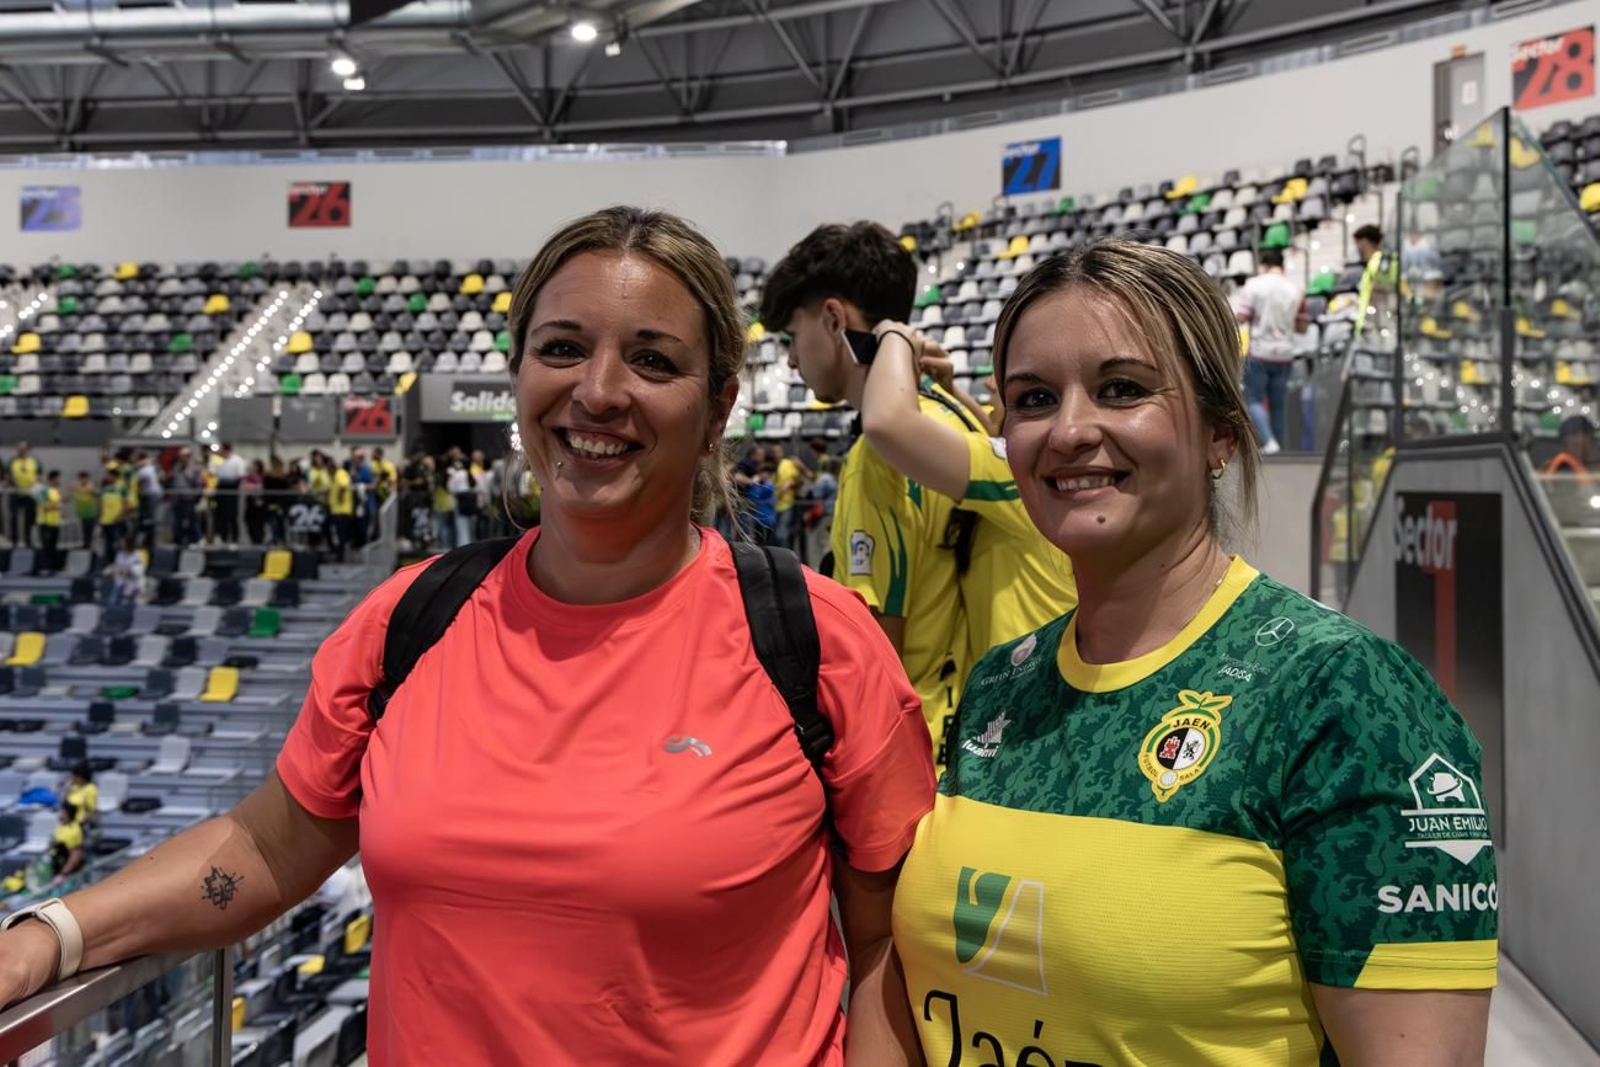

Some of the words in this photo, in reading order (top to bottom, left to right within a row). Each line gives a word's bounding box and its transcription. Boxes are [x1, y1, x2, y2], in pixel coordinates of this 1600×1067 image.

[1513, 27, 1594, 111] 28
[1003, 138, 1060, 194] 27
[289, 183, 350, 227] 26
[345, 397, 391, 433] 26
[1173, 718, 1211, 731] JAEN
[1409, 816, 1450, 832] JUAN
[1453, 816, 1488, 831] EMILIO
[924, 989, 1104, 1067] Jaé
